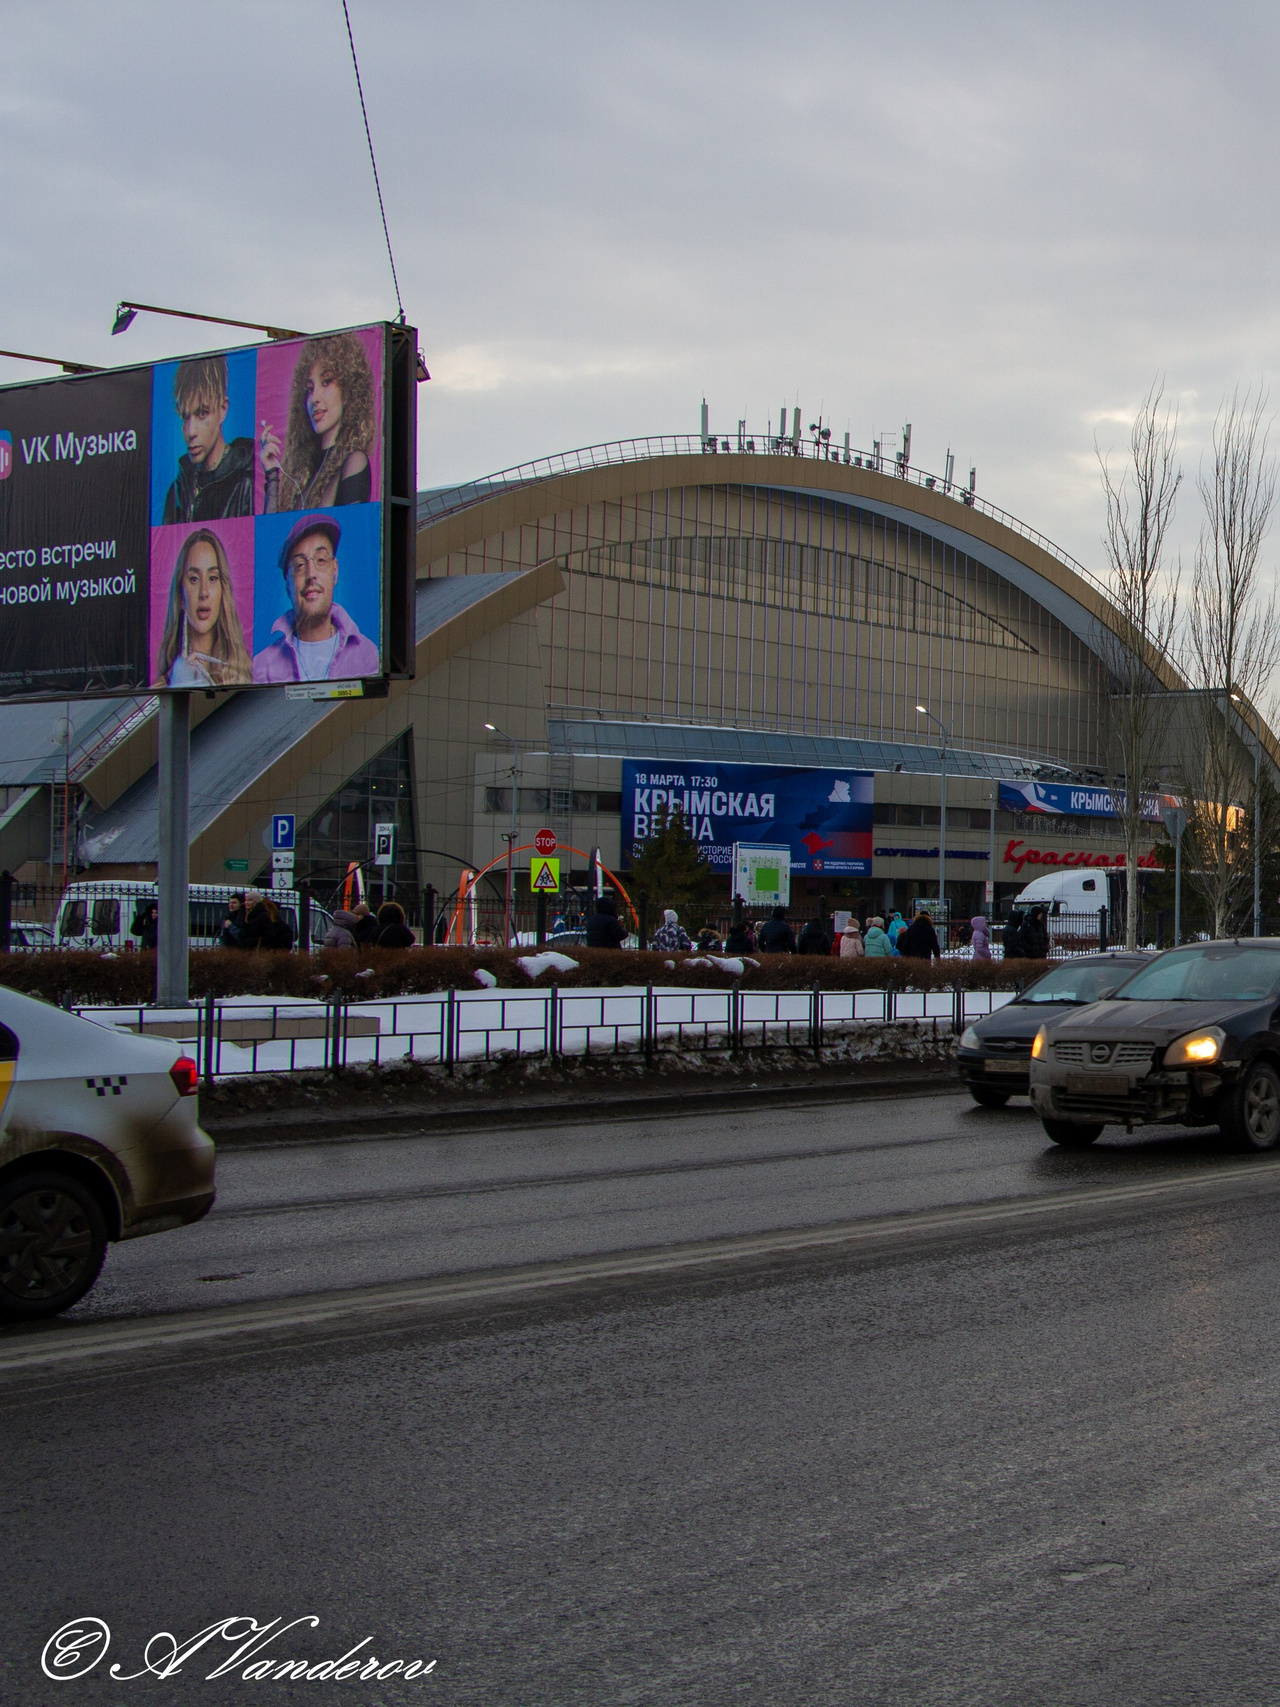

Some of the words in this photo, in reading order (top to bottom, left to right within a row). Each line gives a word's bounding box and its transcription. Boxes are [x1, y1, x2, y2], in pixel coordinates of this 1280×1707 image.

[22, 435, 50, 464] VK
[55, 429, 137, 465] Музыка
[41, 540, 116, 569] встречи
[56, 568, 136, 606] музыкой
[635, 773, 647, 785] 18
[650, 774, 685, 787] МАРТА
[691, 776, 718, 788] 17:30
[634, 788, 775, 818] КРЫМСКАЯ
[277, 819, 289, 844] P
[535, 837, 556, 847] STOP
[1003, 839, 1128, 874] Красная
